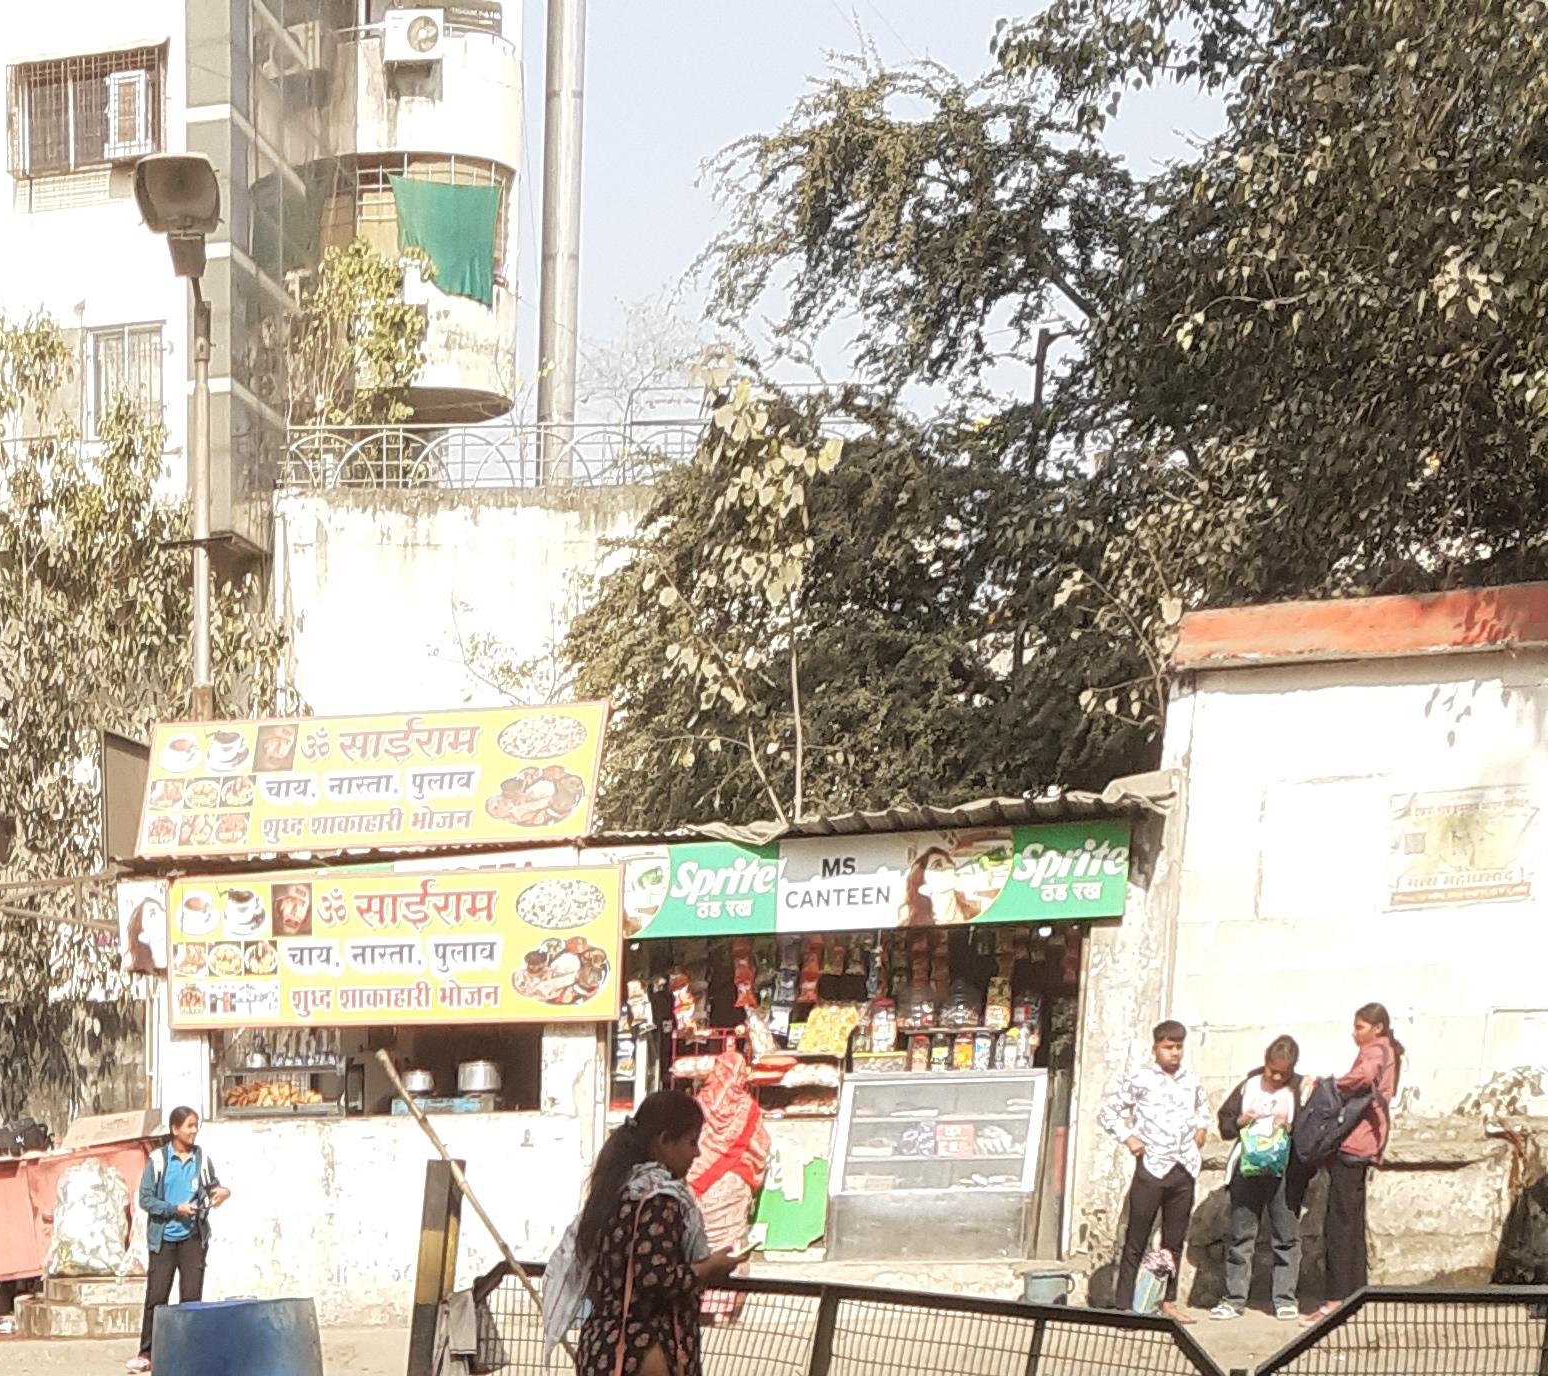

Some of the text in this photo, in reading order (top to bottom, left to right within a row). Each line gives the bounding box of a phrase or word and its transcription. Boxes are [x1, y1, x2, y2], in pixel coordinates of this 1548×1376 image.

[339, 716, 480, 762] साईराम
[411, 770, 475, 800] पुलाव
[311, 807, 404, 835] शाकाहारी
[410, 805, 474, 830] भोजन
[821, 856, 857, 878] MS
[1012, 838, 1130, 888] Sprite
[670, 857, 778, 905] Sprite
[1071, 880, 1104, 901] रख
[353, 878, 497, 930] साईराम
[785, 886, 891, 909] CANTEEN
[433, 941, 497, 973] पुलाव
[339, 980, 433, 1009] शाकाहारी
[439, 979, 501, 1006] भोजन
